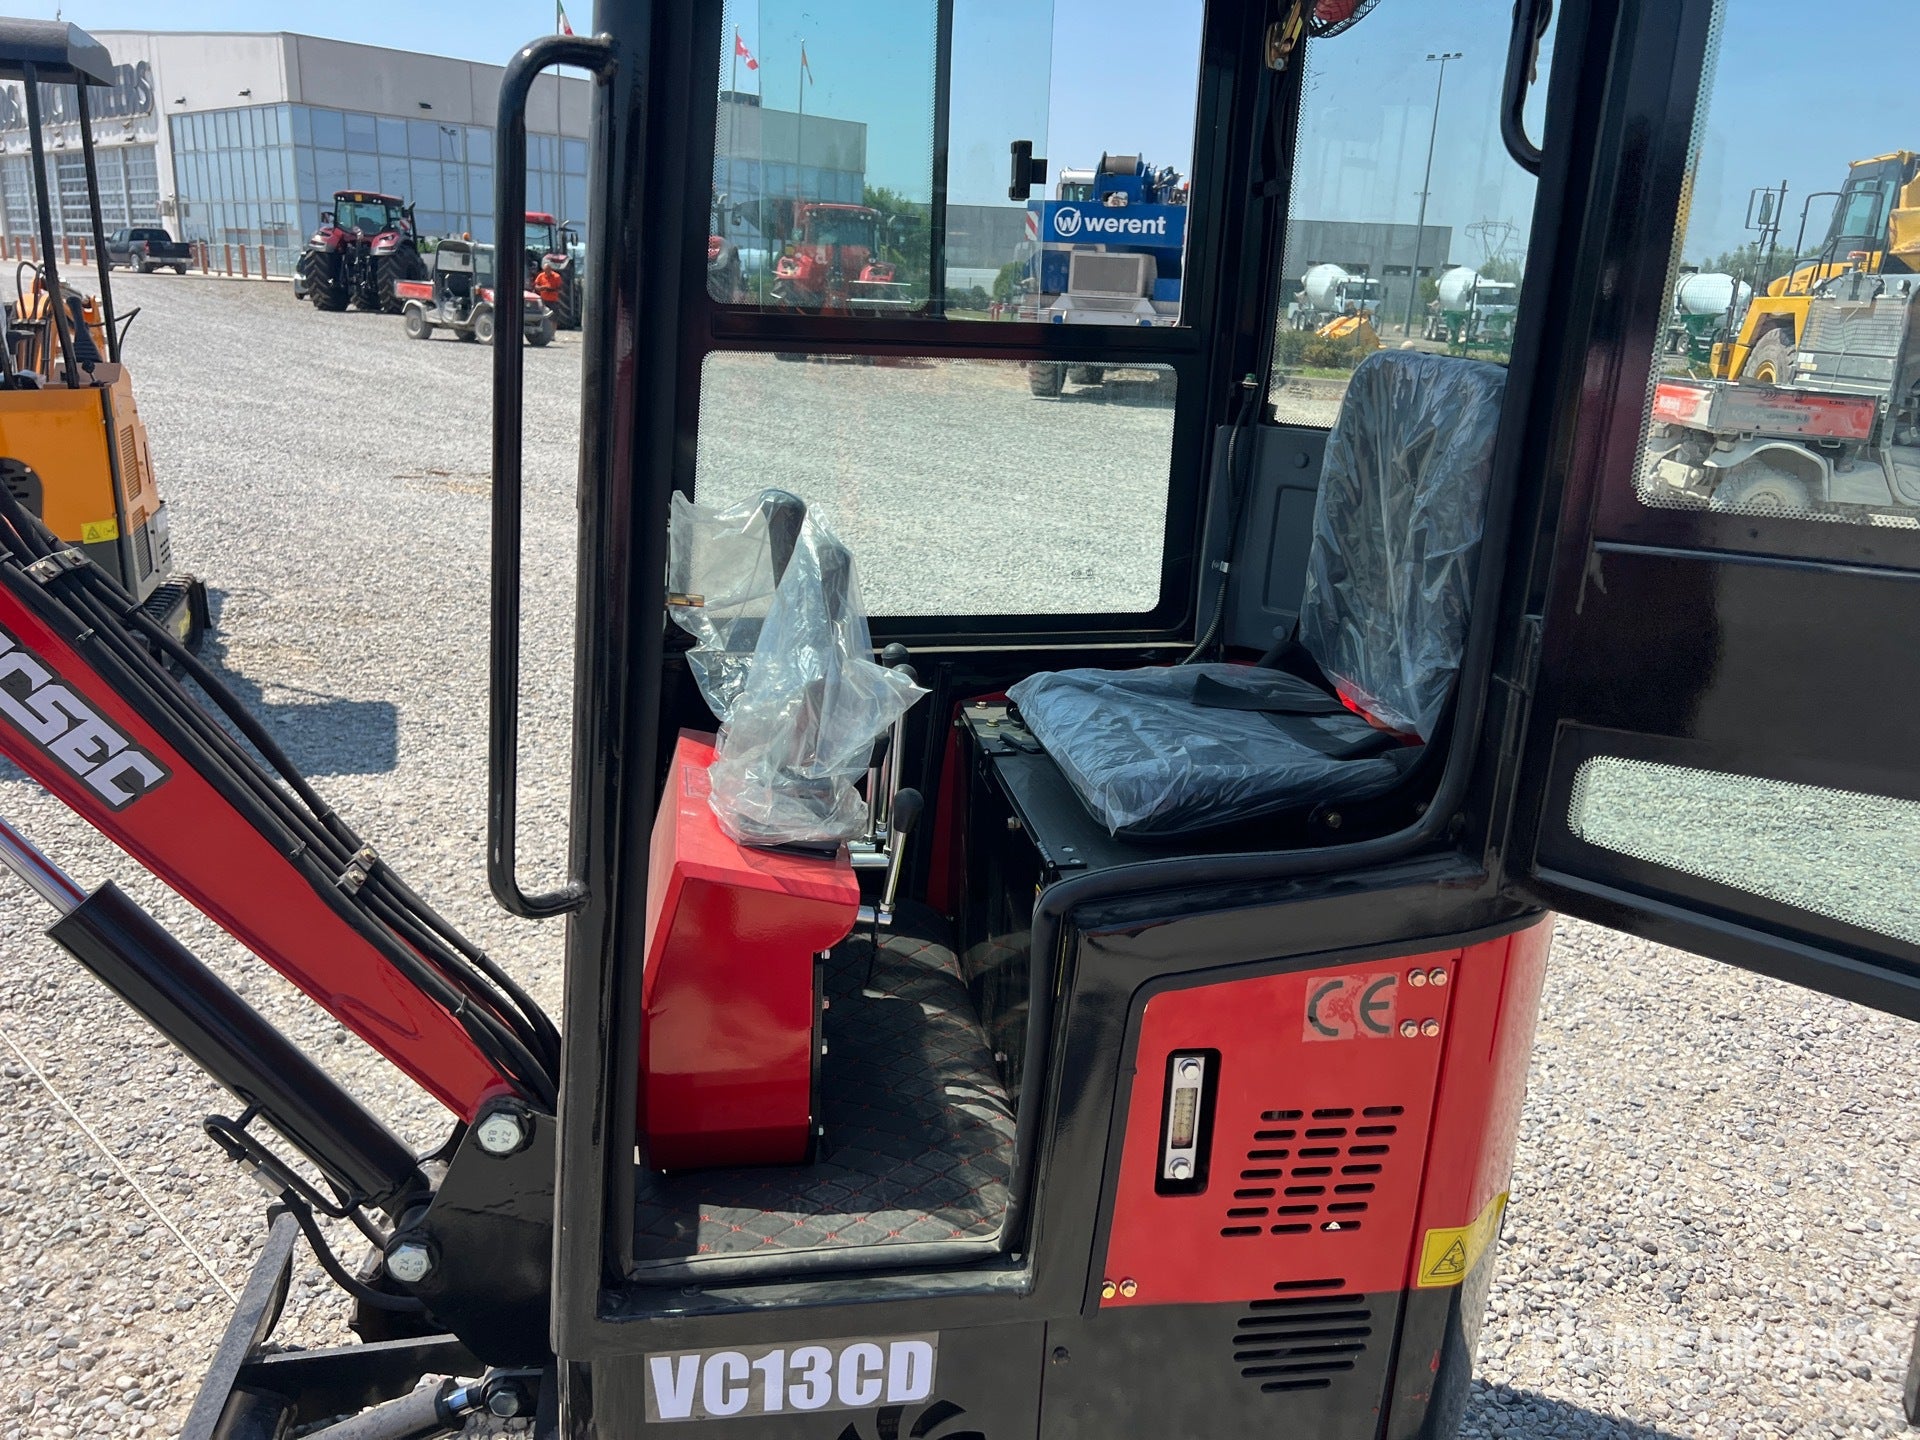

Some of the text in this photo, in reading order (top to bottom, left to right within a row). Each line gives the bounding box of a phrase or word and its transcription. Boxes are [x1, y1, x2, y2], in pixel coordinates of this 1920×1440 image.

[1084, 216, 1167, 235] werent
[1308, 976, 1396, 1036] CE
[650, 1341, 933, 1419] VC13CD
